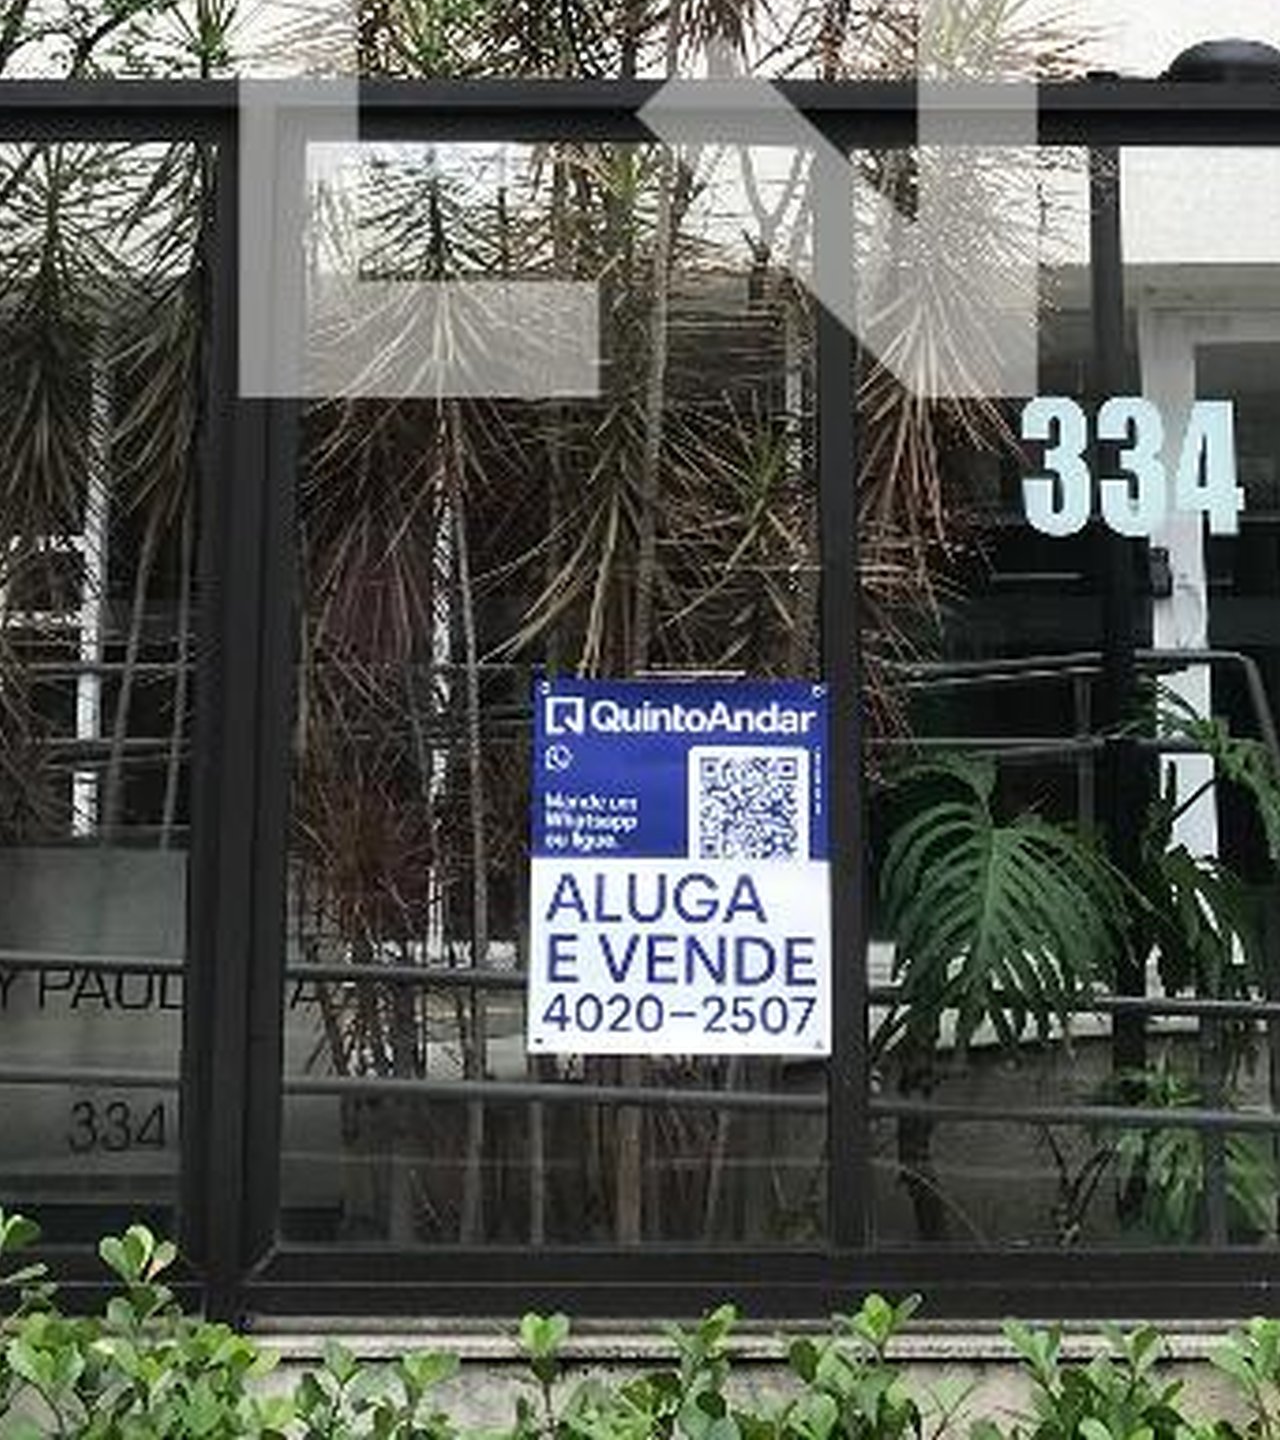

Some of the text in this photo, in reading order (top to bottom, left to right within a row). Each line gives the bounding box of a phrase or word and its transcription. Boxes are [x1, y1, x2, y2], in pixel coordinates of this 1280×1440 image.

[1021, 396, 1246, 537] 334
[590, 699, 817, 734] QuintoAndar
[545, 872, 769, 924] ALUGA
[547, 933, 818, 988] E VENDE
[541, 992, 818, 1036] 4020-2507
[66, 1100, 167, 1154] 334
